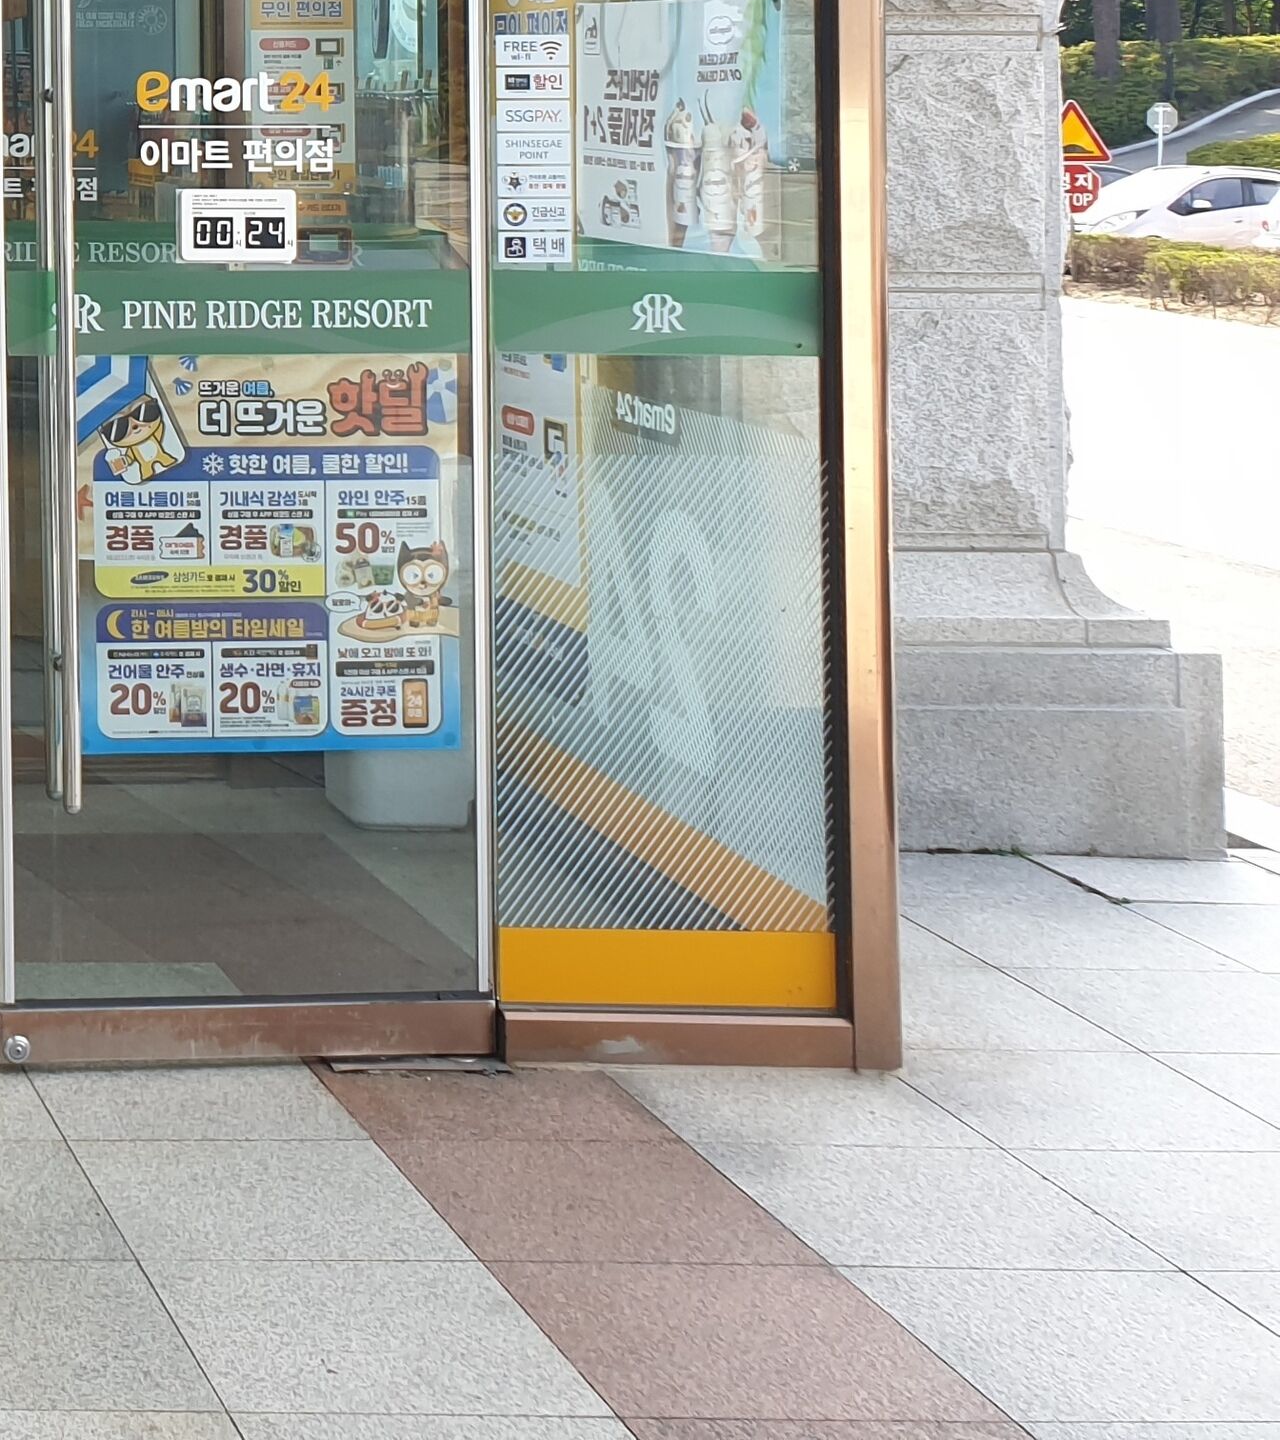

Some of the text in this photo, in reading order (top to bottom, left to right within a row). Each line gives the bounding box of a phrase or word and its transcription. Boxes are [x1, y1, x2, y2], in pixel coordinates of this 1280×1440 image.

[261, 1, 342, 18] 무인 편의점
[503, 41, 538, 52] FREE
[136, 71, 335, 112] emart24
[533, 74, 563, 90] 할인
[505, 140, 563, 148] SHINSEGAE
[140, 138, 233, 174] 이마트
[242, 138, 335, 173] 편의점
[519, 151, 549, 160] POINT
[1063, 192, 1094, 207] TOP
[531, 207, 566, 217] 긴급신고
[248, 220, 283, 246] 24
[88, 241, 177, 263] RESOR
[123, 299, 432, 329] PINE RIDGE RESORT
[199, 380, 274, 397] 뜨거운 여름,
[199, 400, 326, 434] 더 뜨거운
[228, 452, 409, 475] 핫한 여름, 쿨한 할인!
[105, 491, 184, 507] 여름 나들이
[219, 490, 264, 507] 기내식
[267, 490, 297, 506] 감성
[337, 489, 369, 506] 와인
[374, 489, 405, 506] 안주
[105, 525, 154, 551] 경품
[219, 524, 268, 551] 경품
[335, 522, 395, 554] 50%
[242, 569, 289, 593] 30%
[278, 581, 302, 593] 할인
[131, 618, 305, 639] 한 여름밤의 타임세일
[361, 647, 380, 658] 오고
[406, 646, 416, 657] 또
[108, 663, 185, 679] 건어물 안주
[110, 683, 166, 715] 20%
[219, 681, 275, 714] 20%
[340, 685, 397, 697] 24시간 쿠폰
[340, 698, 397, 727] 증정
